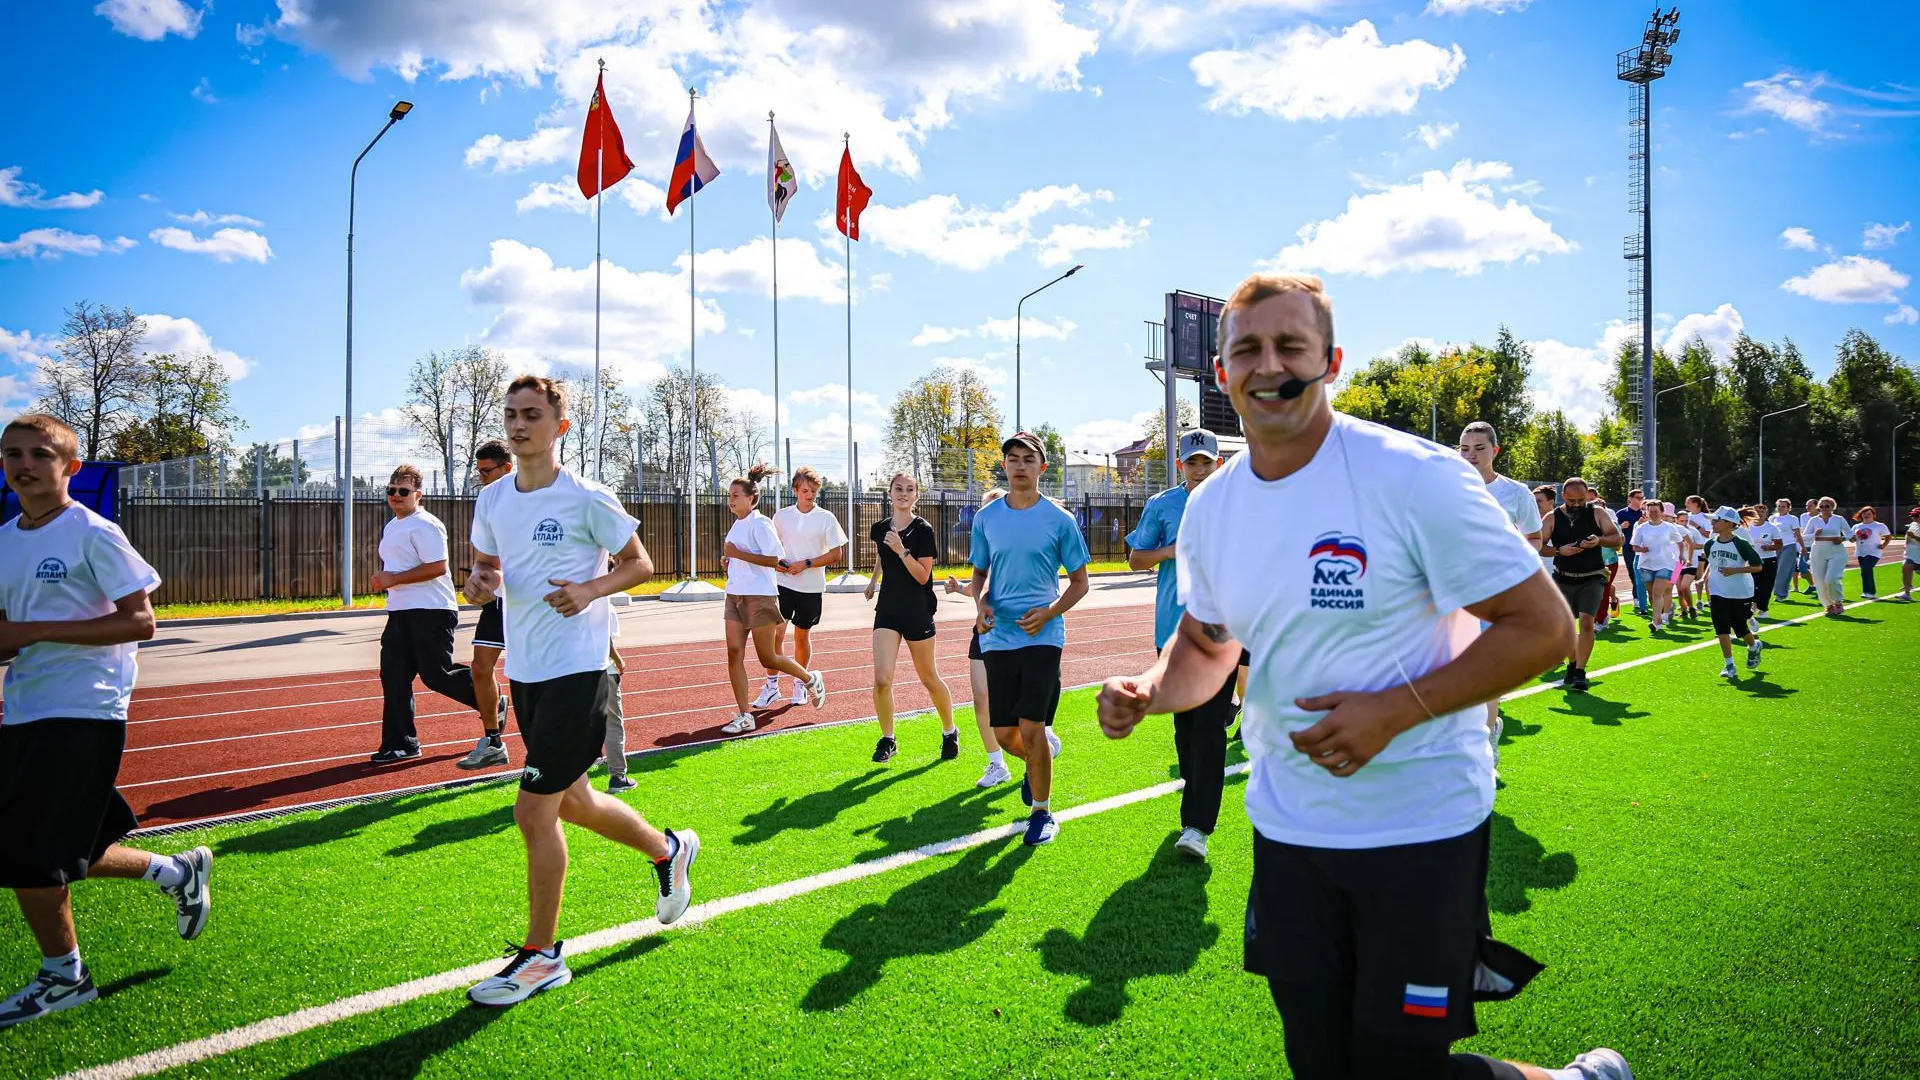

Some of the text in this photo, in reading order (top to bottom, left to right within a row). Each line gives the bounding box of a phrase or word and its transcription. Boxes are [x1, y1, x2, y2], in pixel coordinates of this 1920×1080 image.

[1185, 312, 1198, 321] СЧЕТ
[532, 533, 564, 541] АТЛАНТ
[35, 571, 68, 579] АТЛАНТ
[1310, 588, 1363, 597] ЕДИНАЯ
[1311, 599, 1364, 609] РОССИЯ
